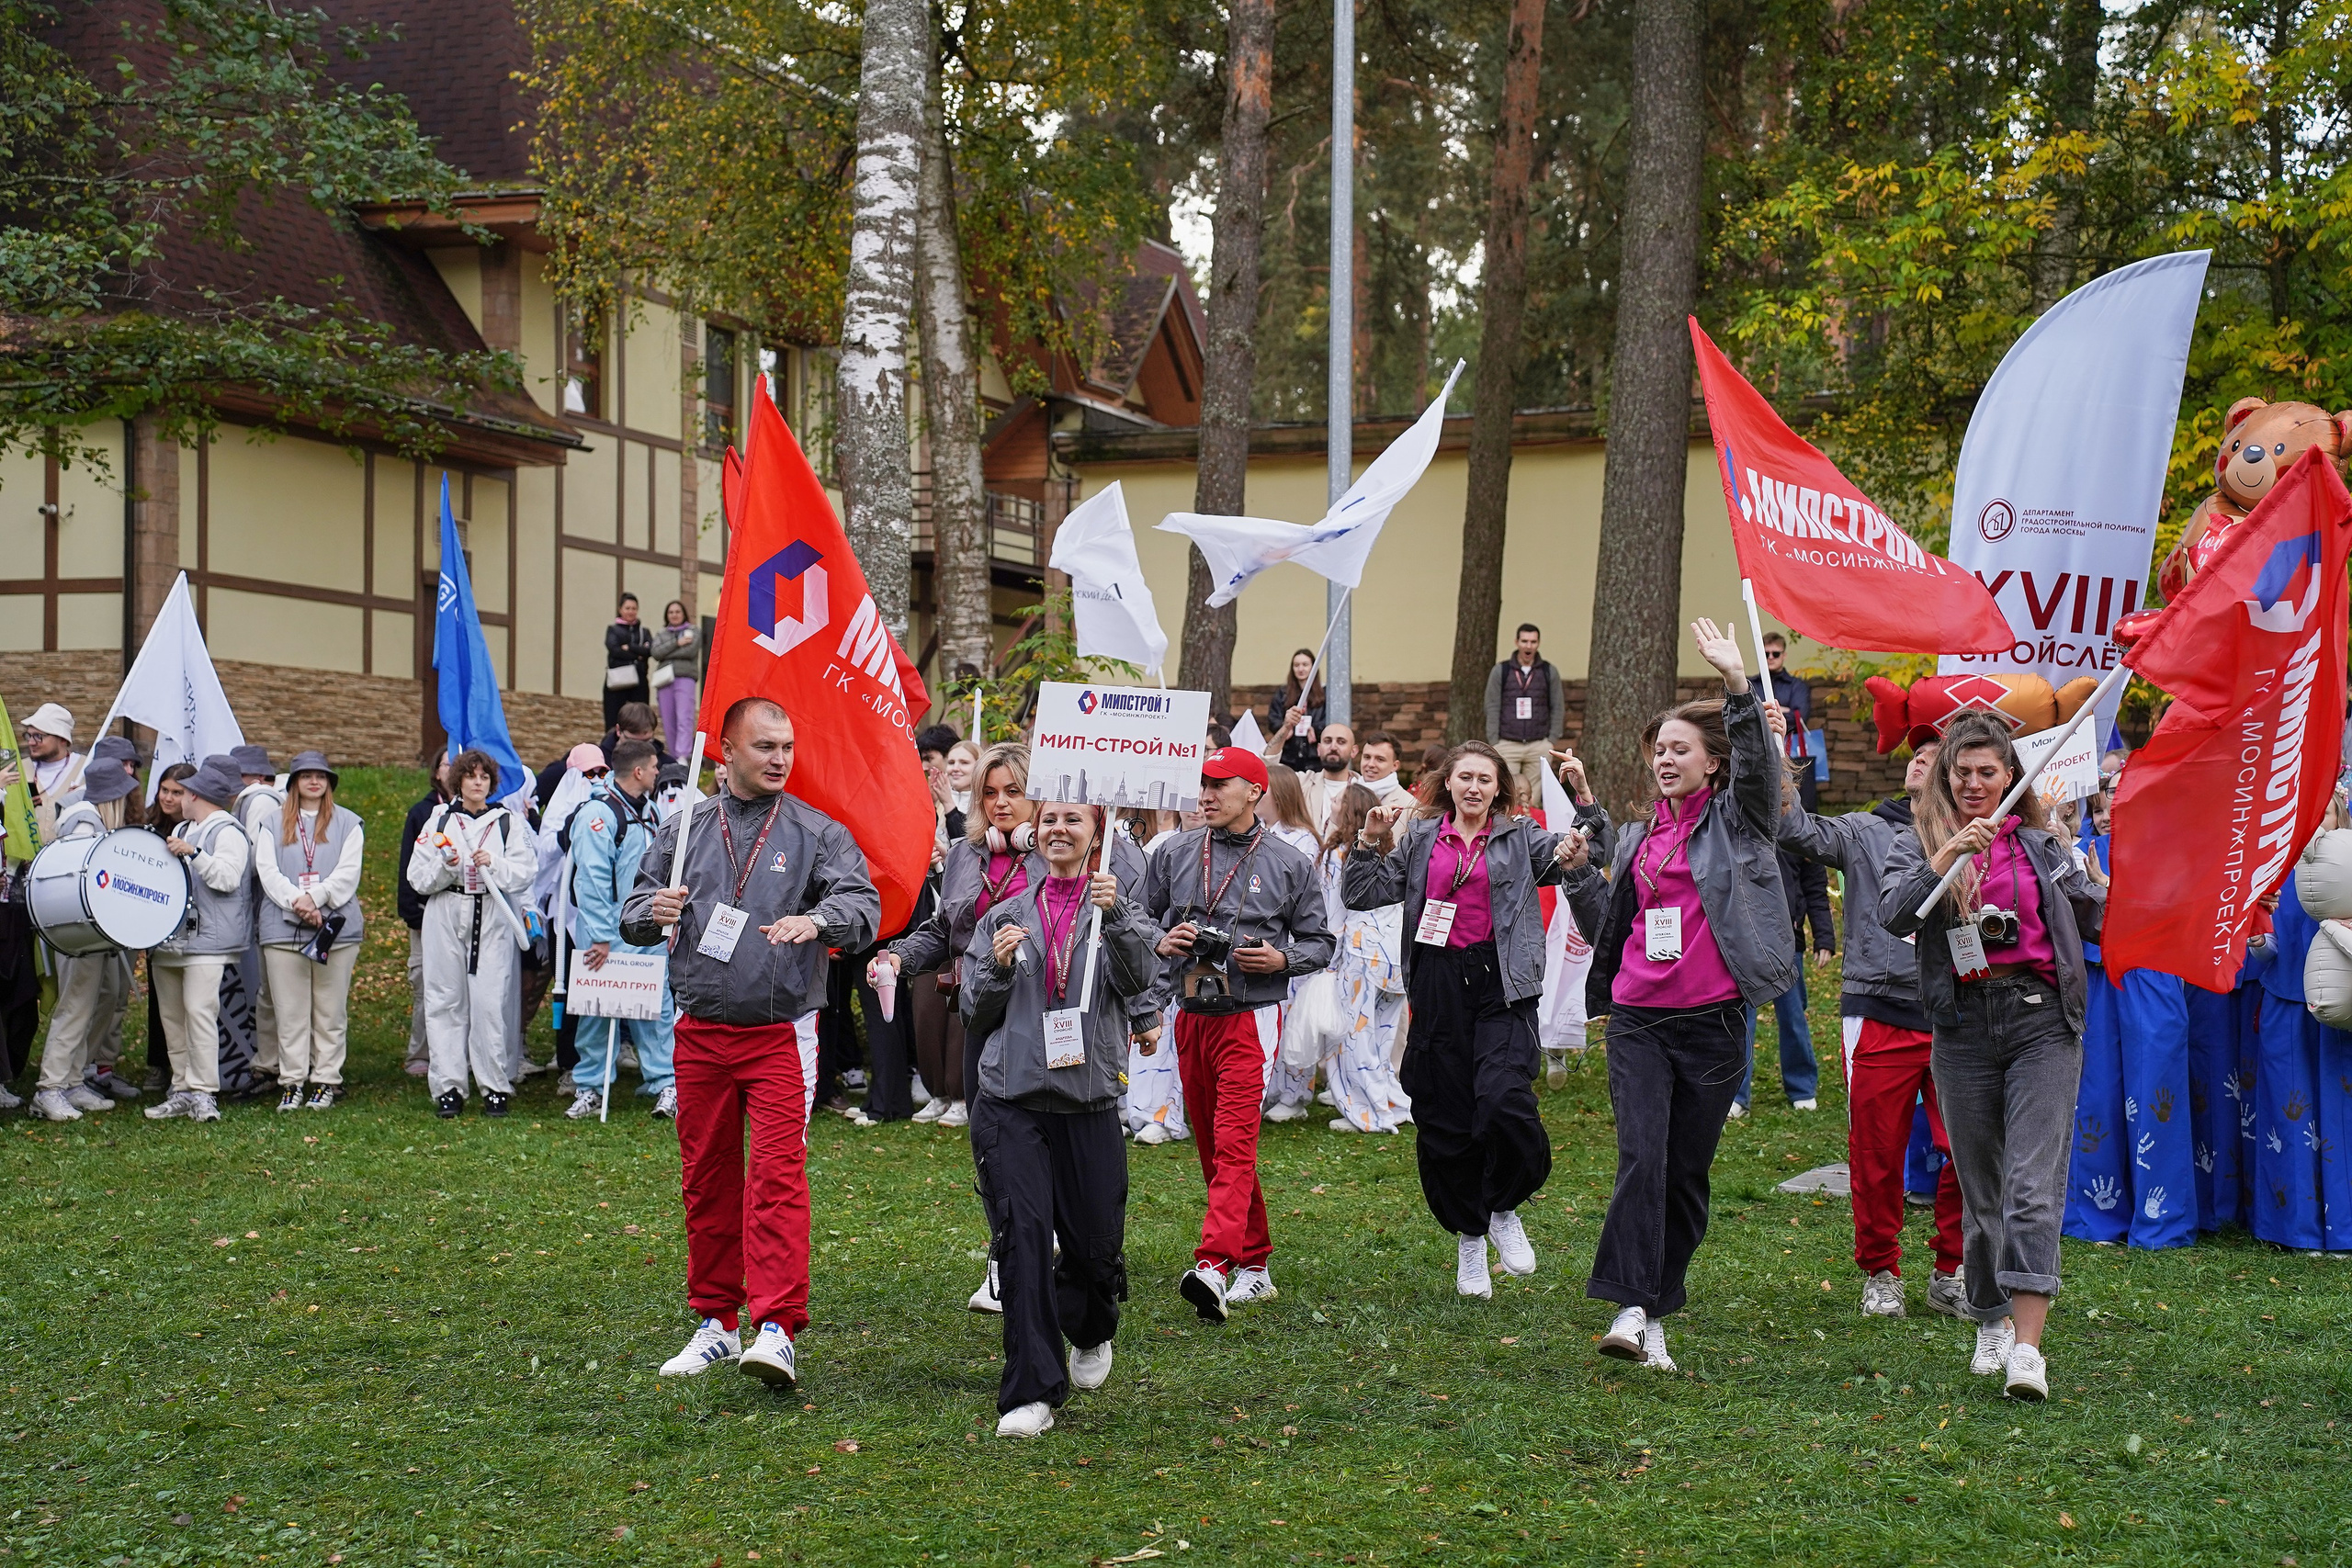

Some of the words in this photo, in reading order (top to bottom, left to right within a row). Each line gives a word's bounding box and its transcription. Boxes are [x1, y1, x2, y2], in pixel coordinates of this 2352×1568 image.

[2022, 509, 2075, 517] ДЕПАРТАМЕНТ
[2020, 526, 2050, 535] ГОРОДА
[2052, 528, 2086, 536] МОСКВЫ
[2021, 518, 2102, 530] ГРАДОСТРОИТЕЛЬНОЙ
[2104, 524, 2146, 535] ПОЛИТИКИ
[822, 663, 855, 694] ГК
[1102, 693, 1161, 713] МИПСТРОЙ
[1165, 696, 1171, 714] 1
[1039, 733, 1162, 757] МИП-СТРОЙ
[1168, 742, 1197, 758] №1
[2212, 707, 2265, 966] «МОСИНЖПРОЕКТ»
[112, 877, 170, 906] МОСИНЖПРОЕКТ
[718, 915, 737, 926] XVIII
[1655, 918, 1672, 926] XVIII
[576, 978, 628, 989] КАПИТАЛ
[629, 982, 657, 991] ГРУП
[1054, 1020, 1073, 1030] XVIII
